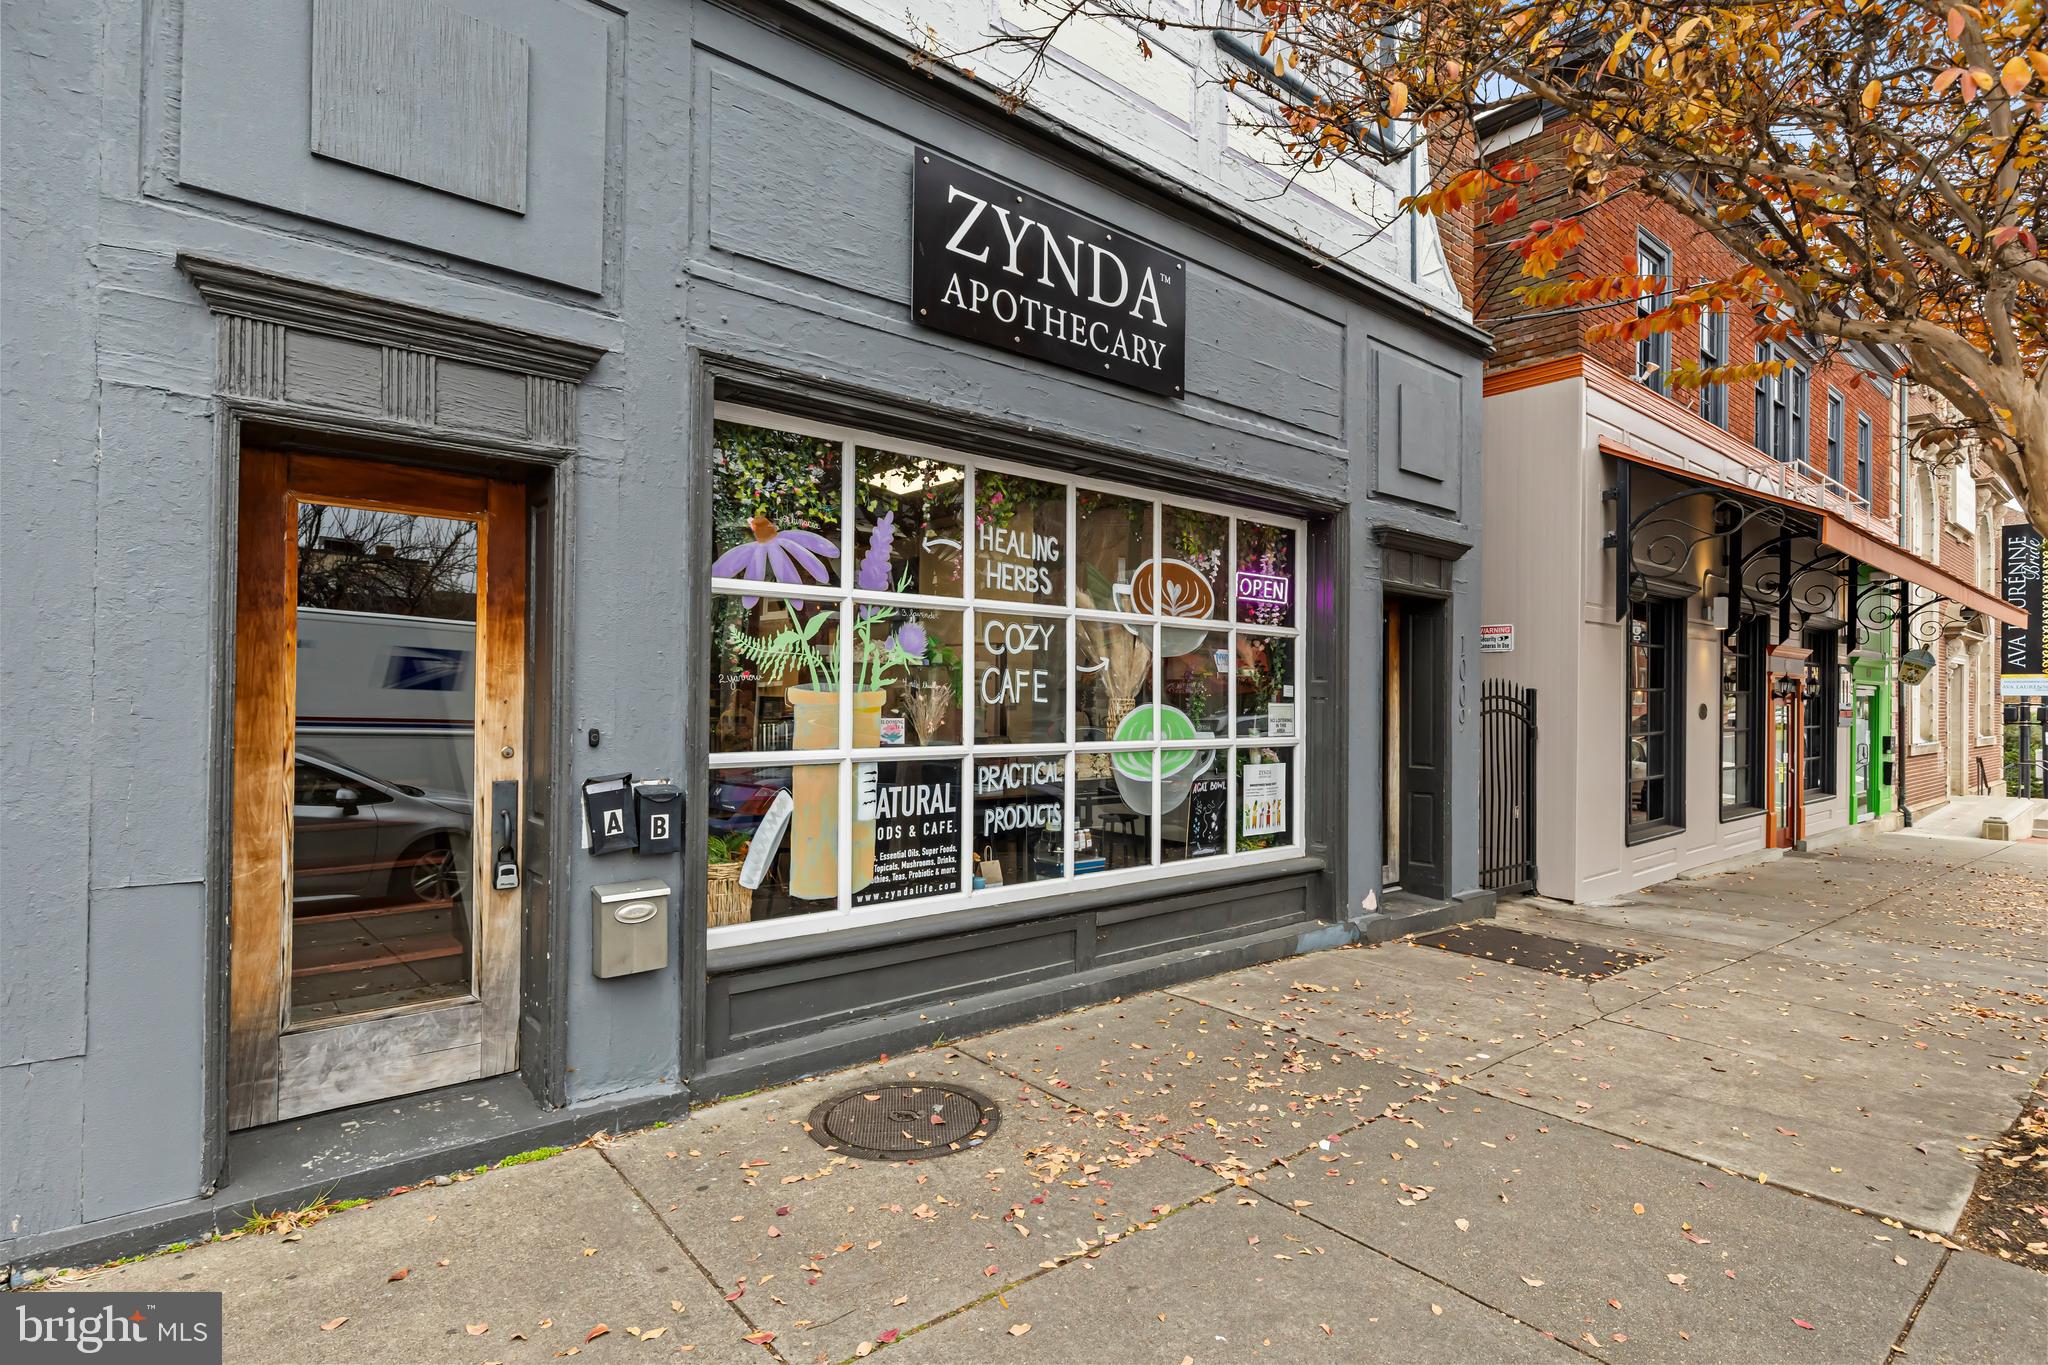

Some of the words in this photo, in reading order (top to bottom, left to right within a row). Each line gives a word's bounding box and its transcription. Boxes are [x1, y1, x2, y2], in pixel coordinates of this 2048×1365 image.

[945, 184, 1168, 327] ZYNDA
[941, 272, 1167, 370] APOTHECARY
[979, 523, 1059, 562] HEALING
[2020, 537, 2041, 580] Bride
[986, 559, 1053, 595] HERBS
[1240, 577, 1285, 600] OPEN
[2003, 536, 2027, 630] URÉNNE
[984, 620, 1055, 655] COZY
[2008, 635, 2027, 668] AVA
[981, 666, 1049, 705] CAFE
[978, 761, 1063, 795] PRACTICAL
[875, 783, 957, 819] ATURAL
[607, 811, 622, 834] A
[652, 816, 667, 838] B
[877, 825, 902, 841] ODS
[908, 825, 916, 837] &
[923, 820, 958, 835] CAFE.
[984, 802, 1061, 837] PRODUCTS
[880, 849, 907, 861] Essential
[922, 846, 939, 858] Super
[909, 868, 934, 880] Probiotic
[857, 882, 957, 903] www.zyndalife.com
